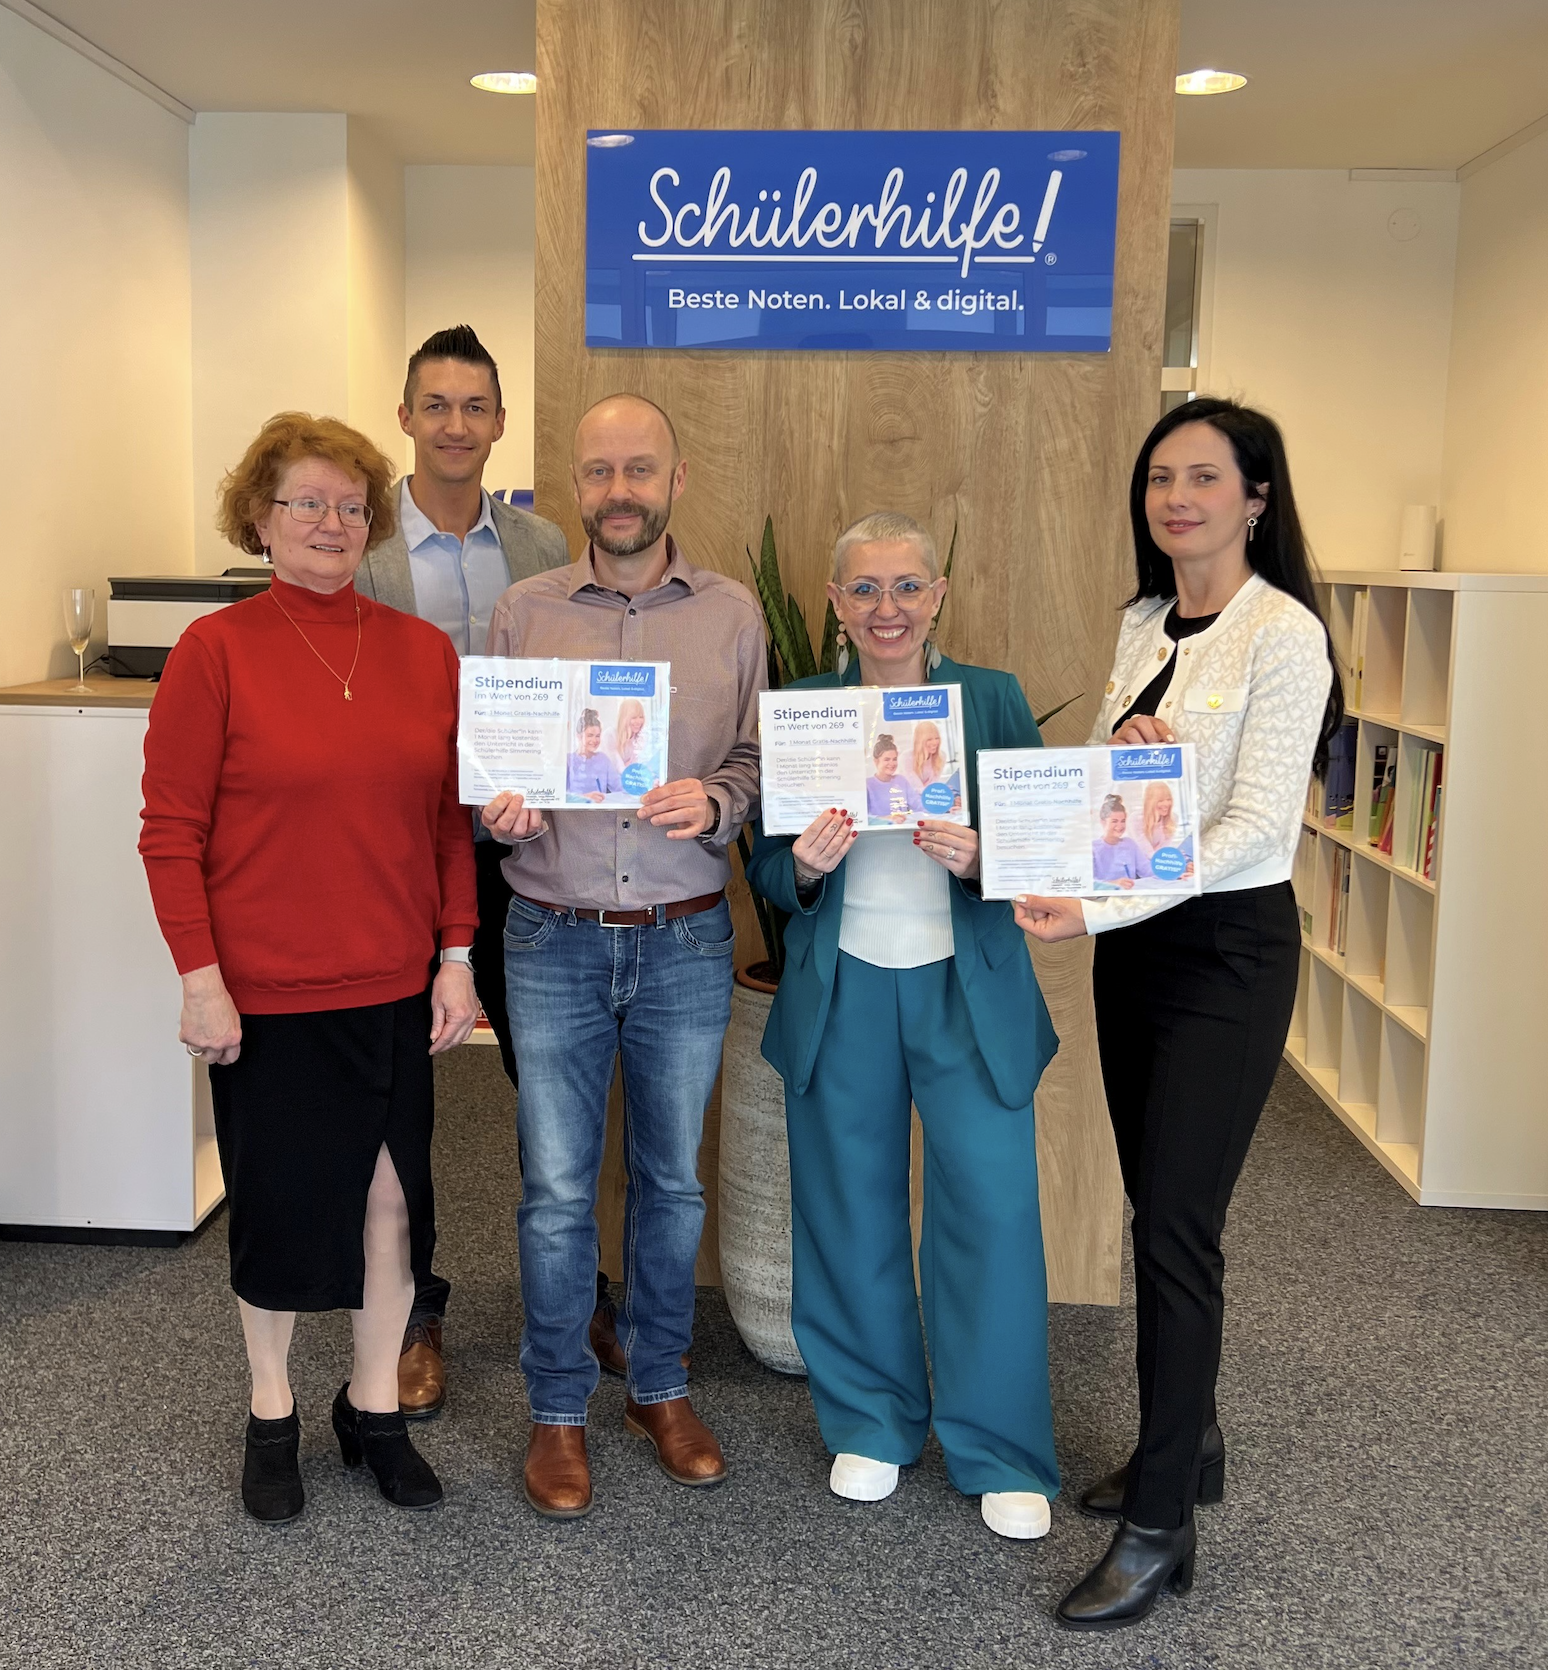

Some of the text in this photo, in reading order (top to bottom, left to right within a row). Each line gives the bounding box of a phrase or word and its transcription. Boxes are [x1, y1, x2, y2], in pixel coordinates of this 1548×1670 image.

[638, 166, 1063, 278] Schülerhilfe!
[668, 289, 1024, 316] Beste Noten. Lokal & digital.
[475, 676, 563, 690] Stipendium
[489, 692, 512, 701] Wert
[532, 693, 549, 701] 269
[773, 706, 858, 722] Stipendium
[787, 723, 809, 731] Wert
[828, 721, 845, 729] 269
[852, 721, 859, 729] €
[993, 765, 1083, 782] Stipendium
[993, 783, 1006, 791] im
[1007, 783, 1031, 791] Wert
[1051, 781, 1069, 790] 269
[1077, 780, 1085, 789] €
